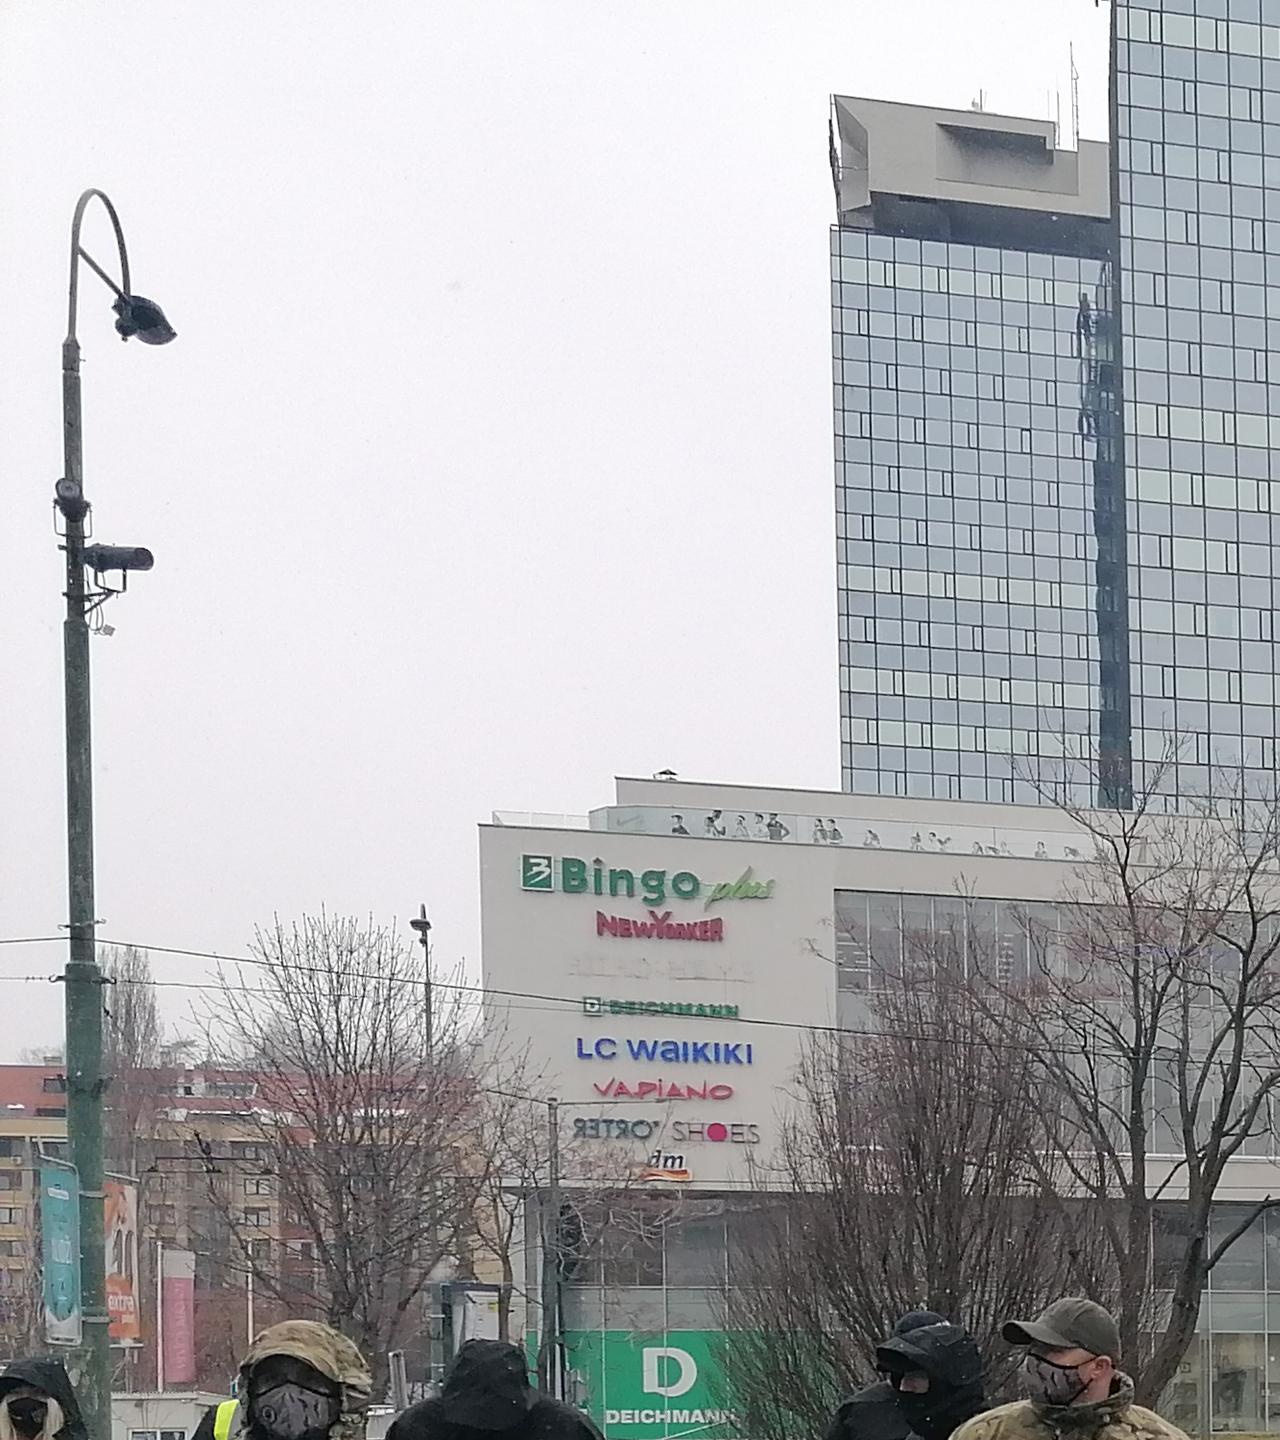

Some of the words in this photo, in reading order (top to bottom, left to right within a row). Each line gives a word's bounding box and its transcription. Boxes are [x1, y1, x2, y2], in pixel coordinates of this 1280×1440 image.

[561, 857, 701, 907] Bingo
[704, 865, 776, 912] plus
[576, 1037, 617, 1061] LC
[651, 1150, 684, 1170] dm
[643, 1347, 697, 1397] D
